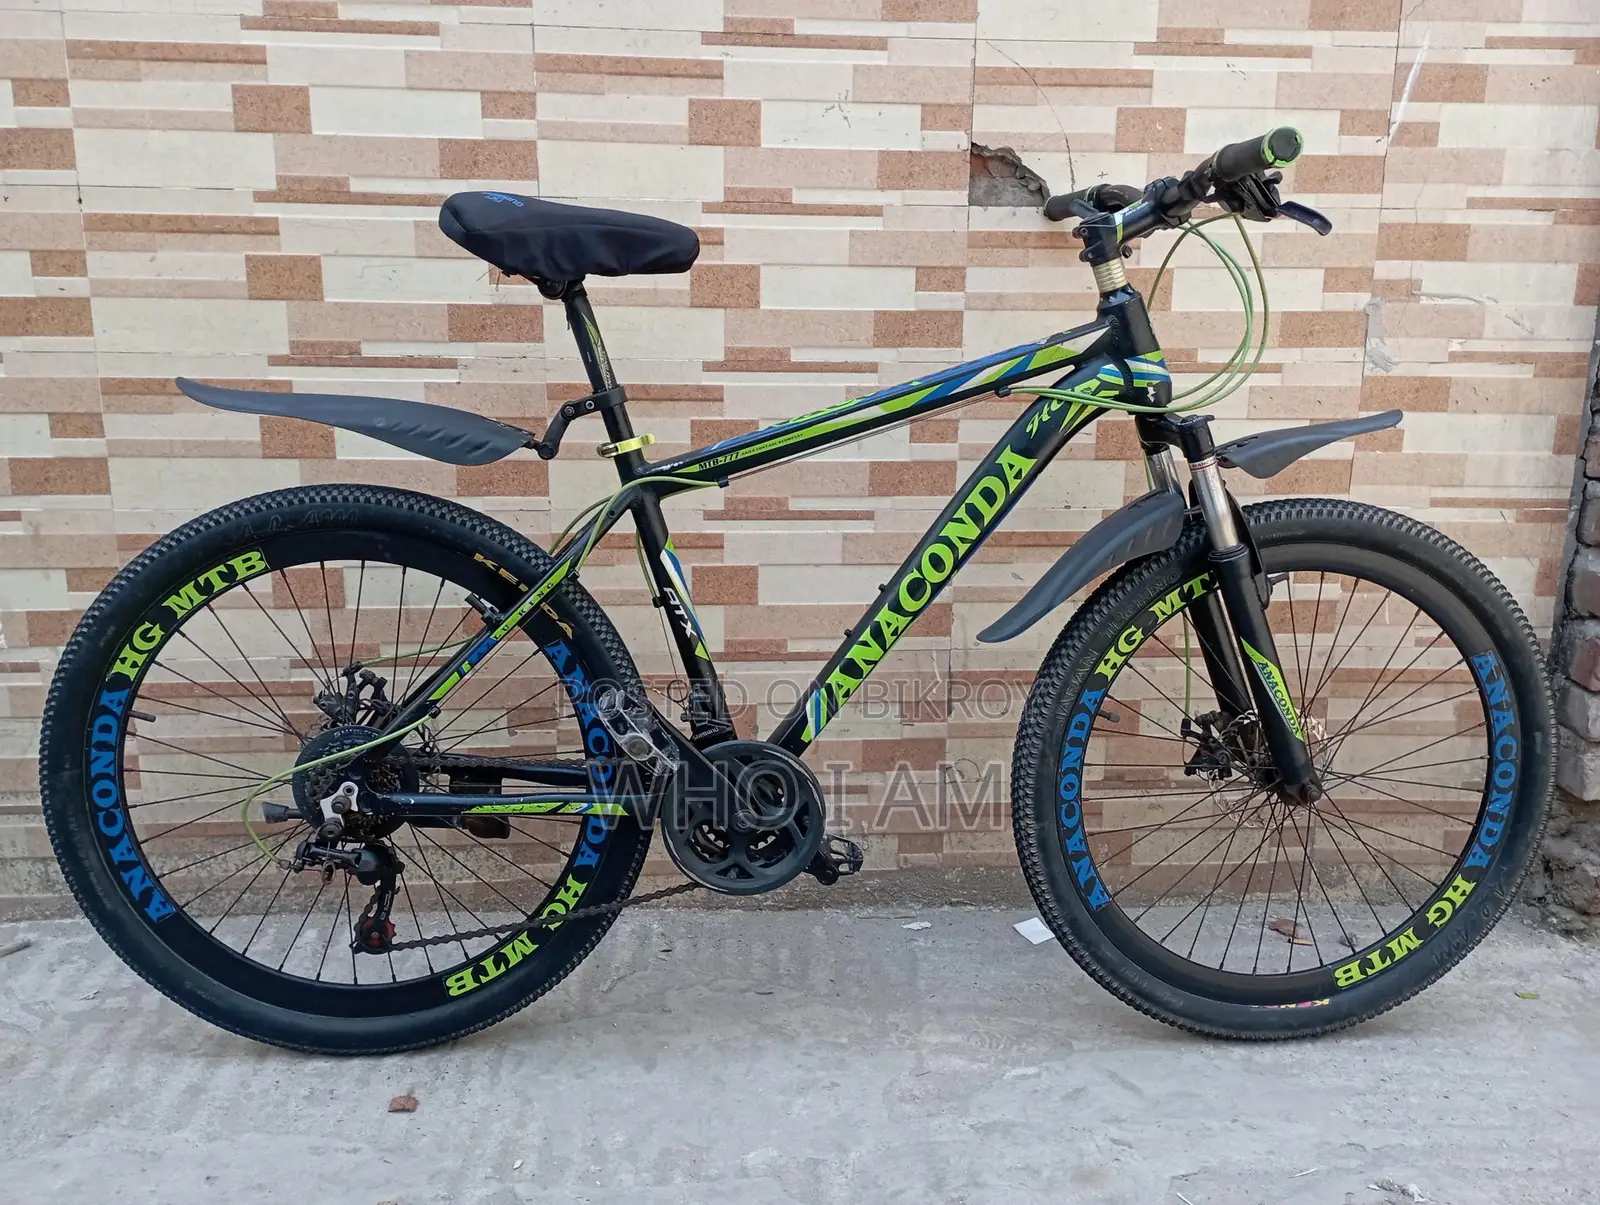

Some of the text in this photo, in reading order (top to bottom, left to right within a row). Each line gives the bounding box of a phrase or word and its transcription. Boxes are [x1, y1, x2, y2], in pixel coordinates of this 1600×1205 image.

[698, 451, 740, 471] MTB-777
[111, 551, 266, 681] HG MTB
[663, 587, 697, 638] ATX
[824, 444, 1038, 707] ANACONDA
[1094, 571, 1219, 681] HG MT
[1259, 662, 1300, 736] ANACONDA
[1059, 688, 1112, 911] ANACONDA
[1472, 651, 1518, 868] ANACONDA
[90, 688, 177, 924] ANACONDA
[1425, 873, 1477, 928] HG
[445, 930, 540, 997] MTB
[1333, 927, 1425, 987] MTB
